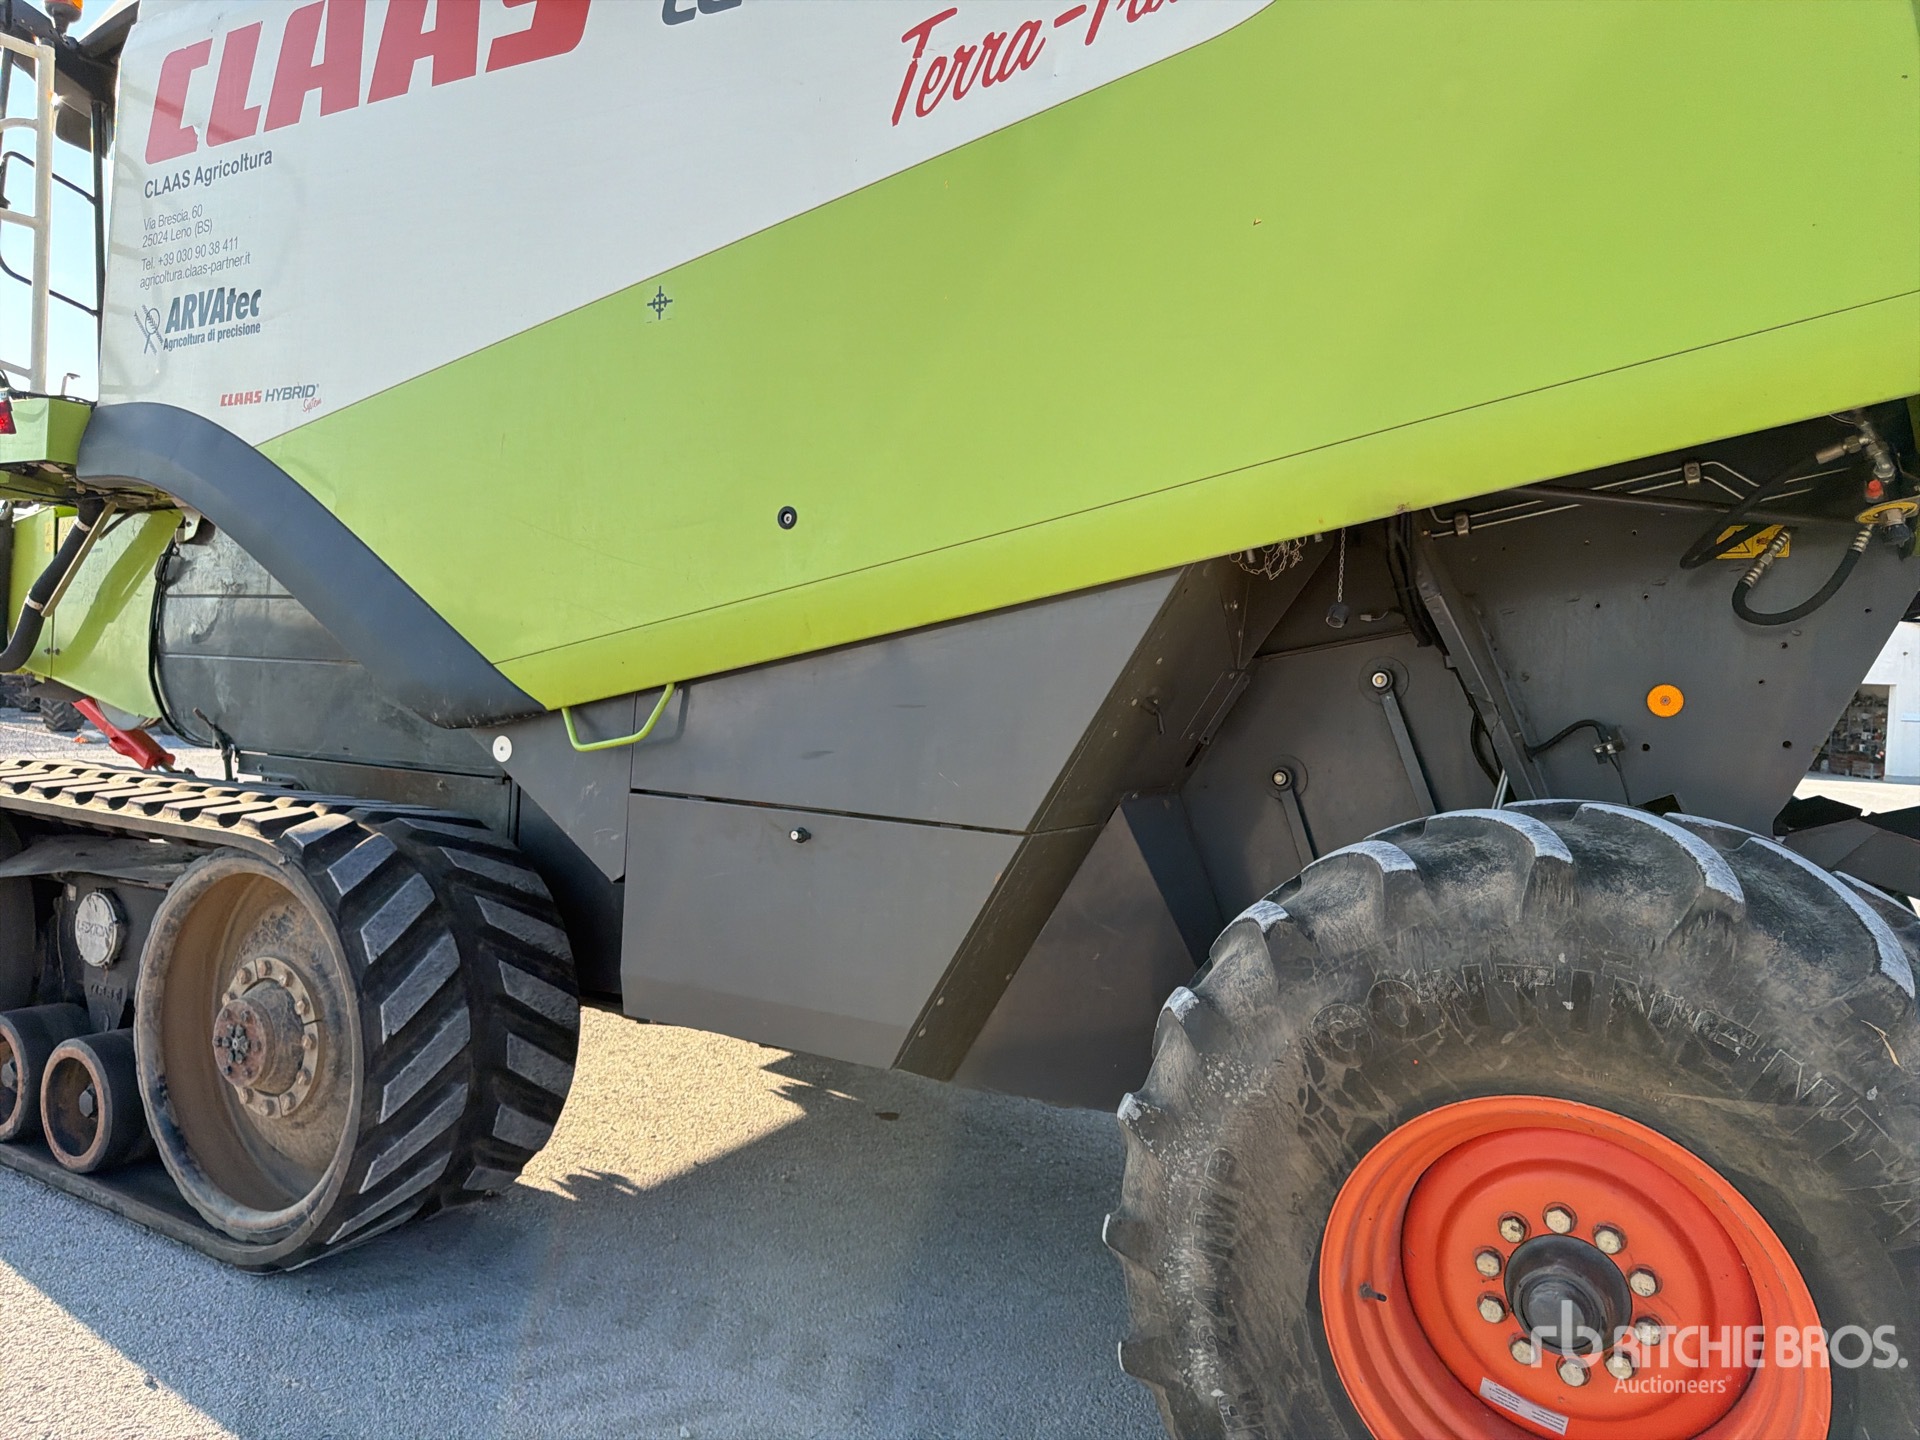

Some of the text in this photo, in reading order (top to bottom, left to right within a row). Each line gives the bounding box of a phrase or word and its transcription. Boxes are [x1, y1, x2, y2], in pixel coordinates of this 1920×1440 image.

[145, 0, 592, 165] CLAAS
[144, 150, 273, 199] CLAAS Agricoltura
[142, 218, 213, 248] 25024 Leno (BS)
[144, 204, 203, 231] Via Brescia, 60
[140, 251, 251, 291] agricoltura.claas-partner.it
[141, 236, 239, 271] Tel. +39 030 90 38 411
[165, 286, 262, 334] ARVAtec
[163, 321, 261, 351] Agricoltura di precisione
[220, 390, 262, 407] CLAAS
